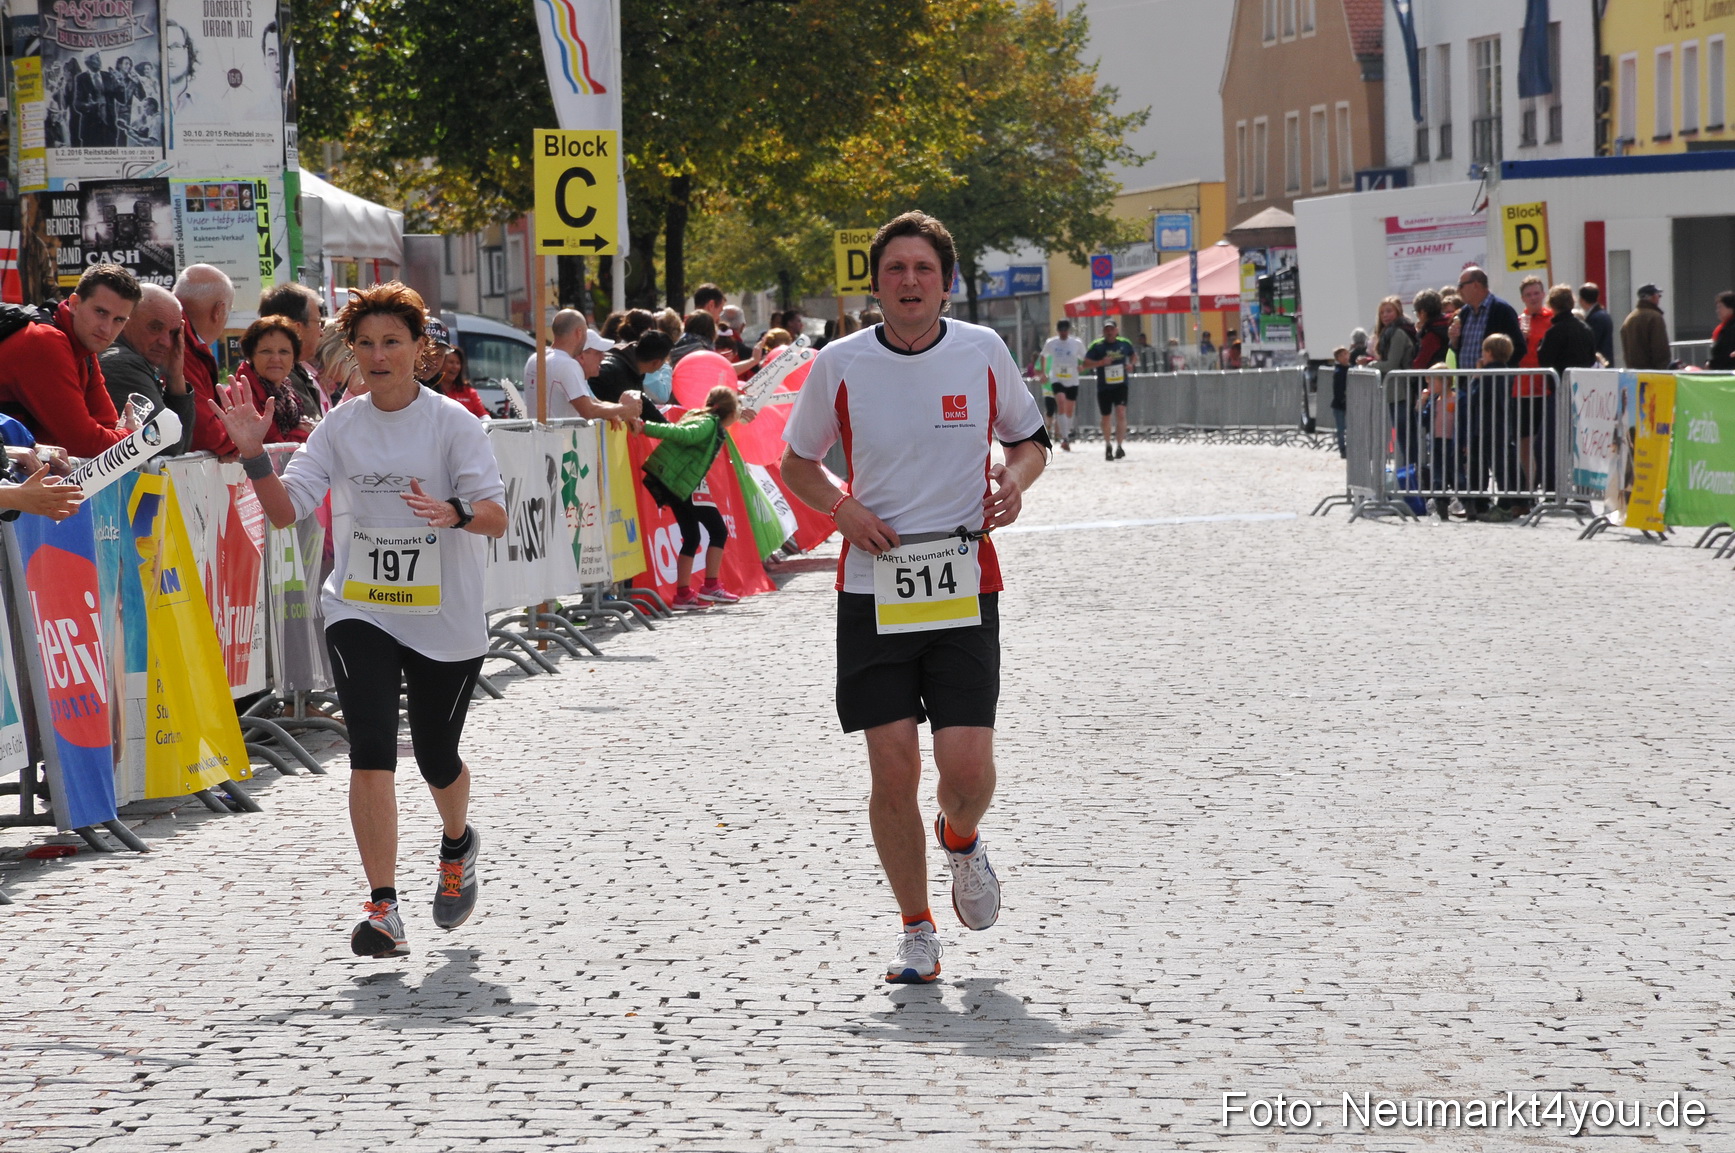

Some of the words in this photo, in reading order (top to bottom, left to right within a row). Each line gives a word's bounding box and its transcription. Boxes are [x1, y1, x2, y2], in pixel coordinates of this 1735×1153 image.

[1663, 0, 1695, 33] HOTEL
[58, 30, 97, 47] BUENA
[99, 30, 131, 47] VISTA
[202, 20, 233, 38] URBAN
[238, 20, 253, 39] JAZZ
[68, 148, 82, 156] 2016
[544, 134, 608, 157] Block
[555, 166, 597, 228] C
[52, 199, 79, 216] MARK
[1506, 206, 1543, 219] Block
[46, 217, 80, 236] BENDER
[173, 198, 184, 241] Sukkulenten
[1406, 242, 1454, 255] DAHMIT
[1516, 223, 1539, 256] D
[56, 247, 81, 264] BAND
[85, 250, 140, 265] CASH
[847, 249, 869, 280] D
[945, 410, 966, 419] DKMS
[104, 434, 140, 473] BMW
[376, 536, 422, 546] Neumarkt
[876, 552, 907, 564] PARTL
[908, 547, 955, 563] Neumarkt
[368, 548, 421, 582] 197
[896, 562, 957, 599] 514
[368, 588, 413, 603] Kerstin
